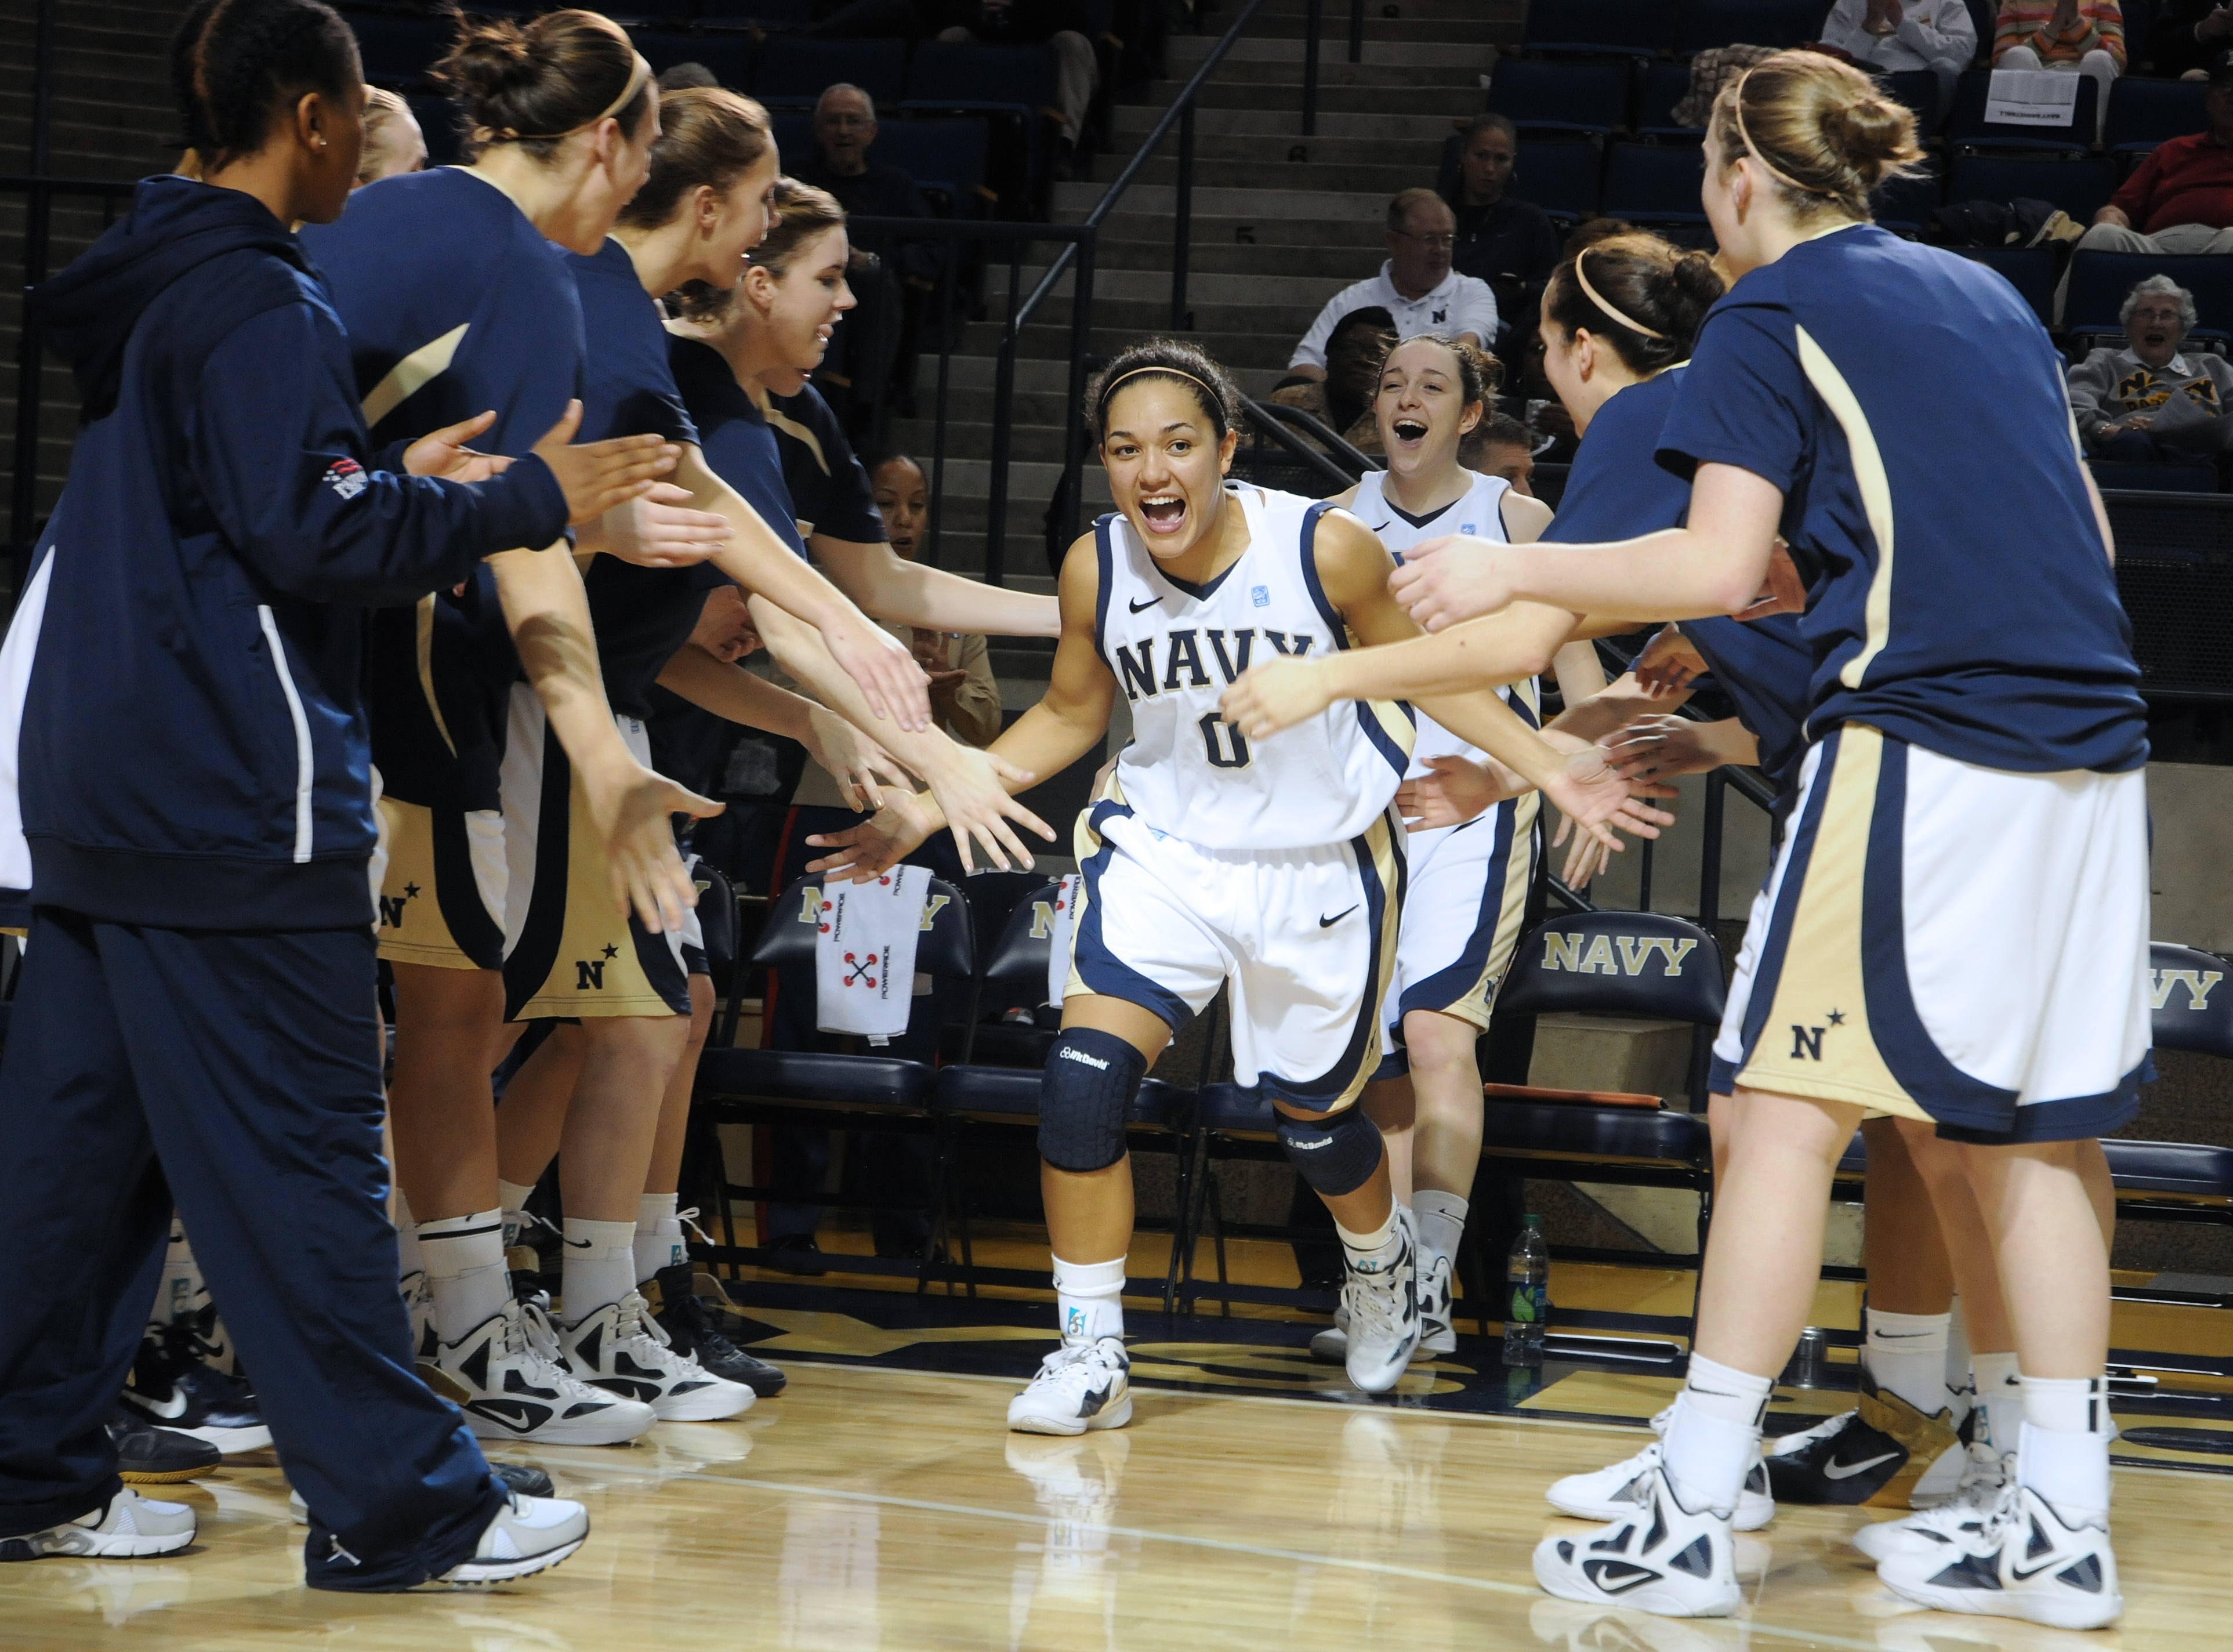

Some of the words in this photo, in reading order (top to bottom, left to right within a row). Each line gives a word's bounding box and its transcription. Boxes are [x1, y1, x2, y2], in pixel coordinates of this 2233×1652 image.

[1432, 309, 1446, 324] N
[1197, 711, 1253, 769] 0
[882, 944, 890, 1000] POWERADE
[1541, 932, 1698, 976] NAVY
[576, 961, 606, 990] N
[2148, 968, 2224, 1010] VY
[1790, 1025, 1826, 1060] N
